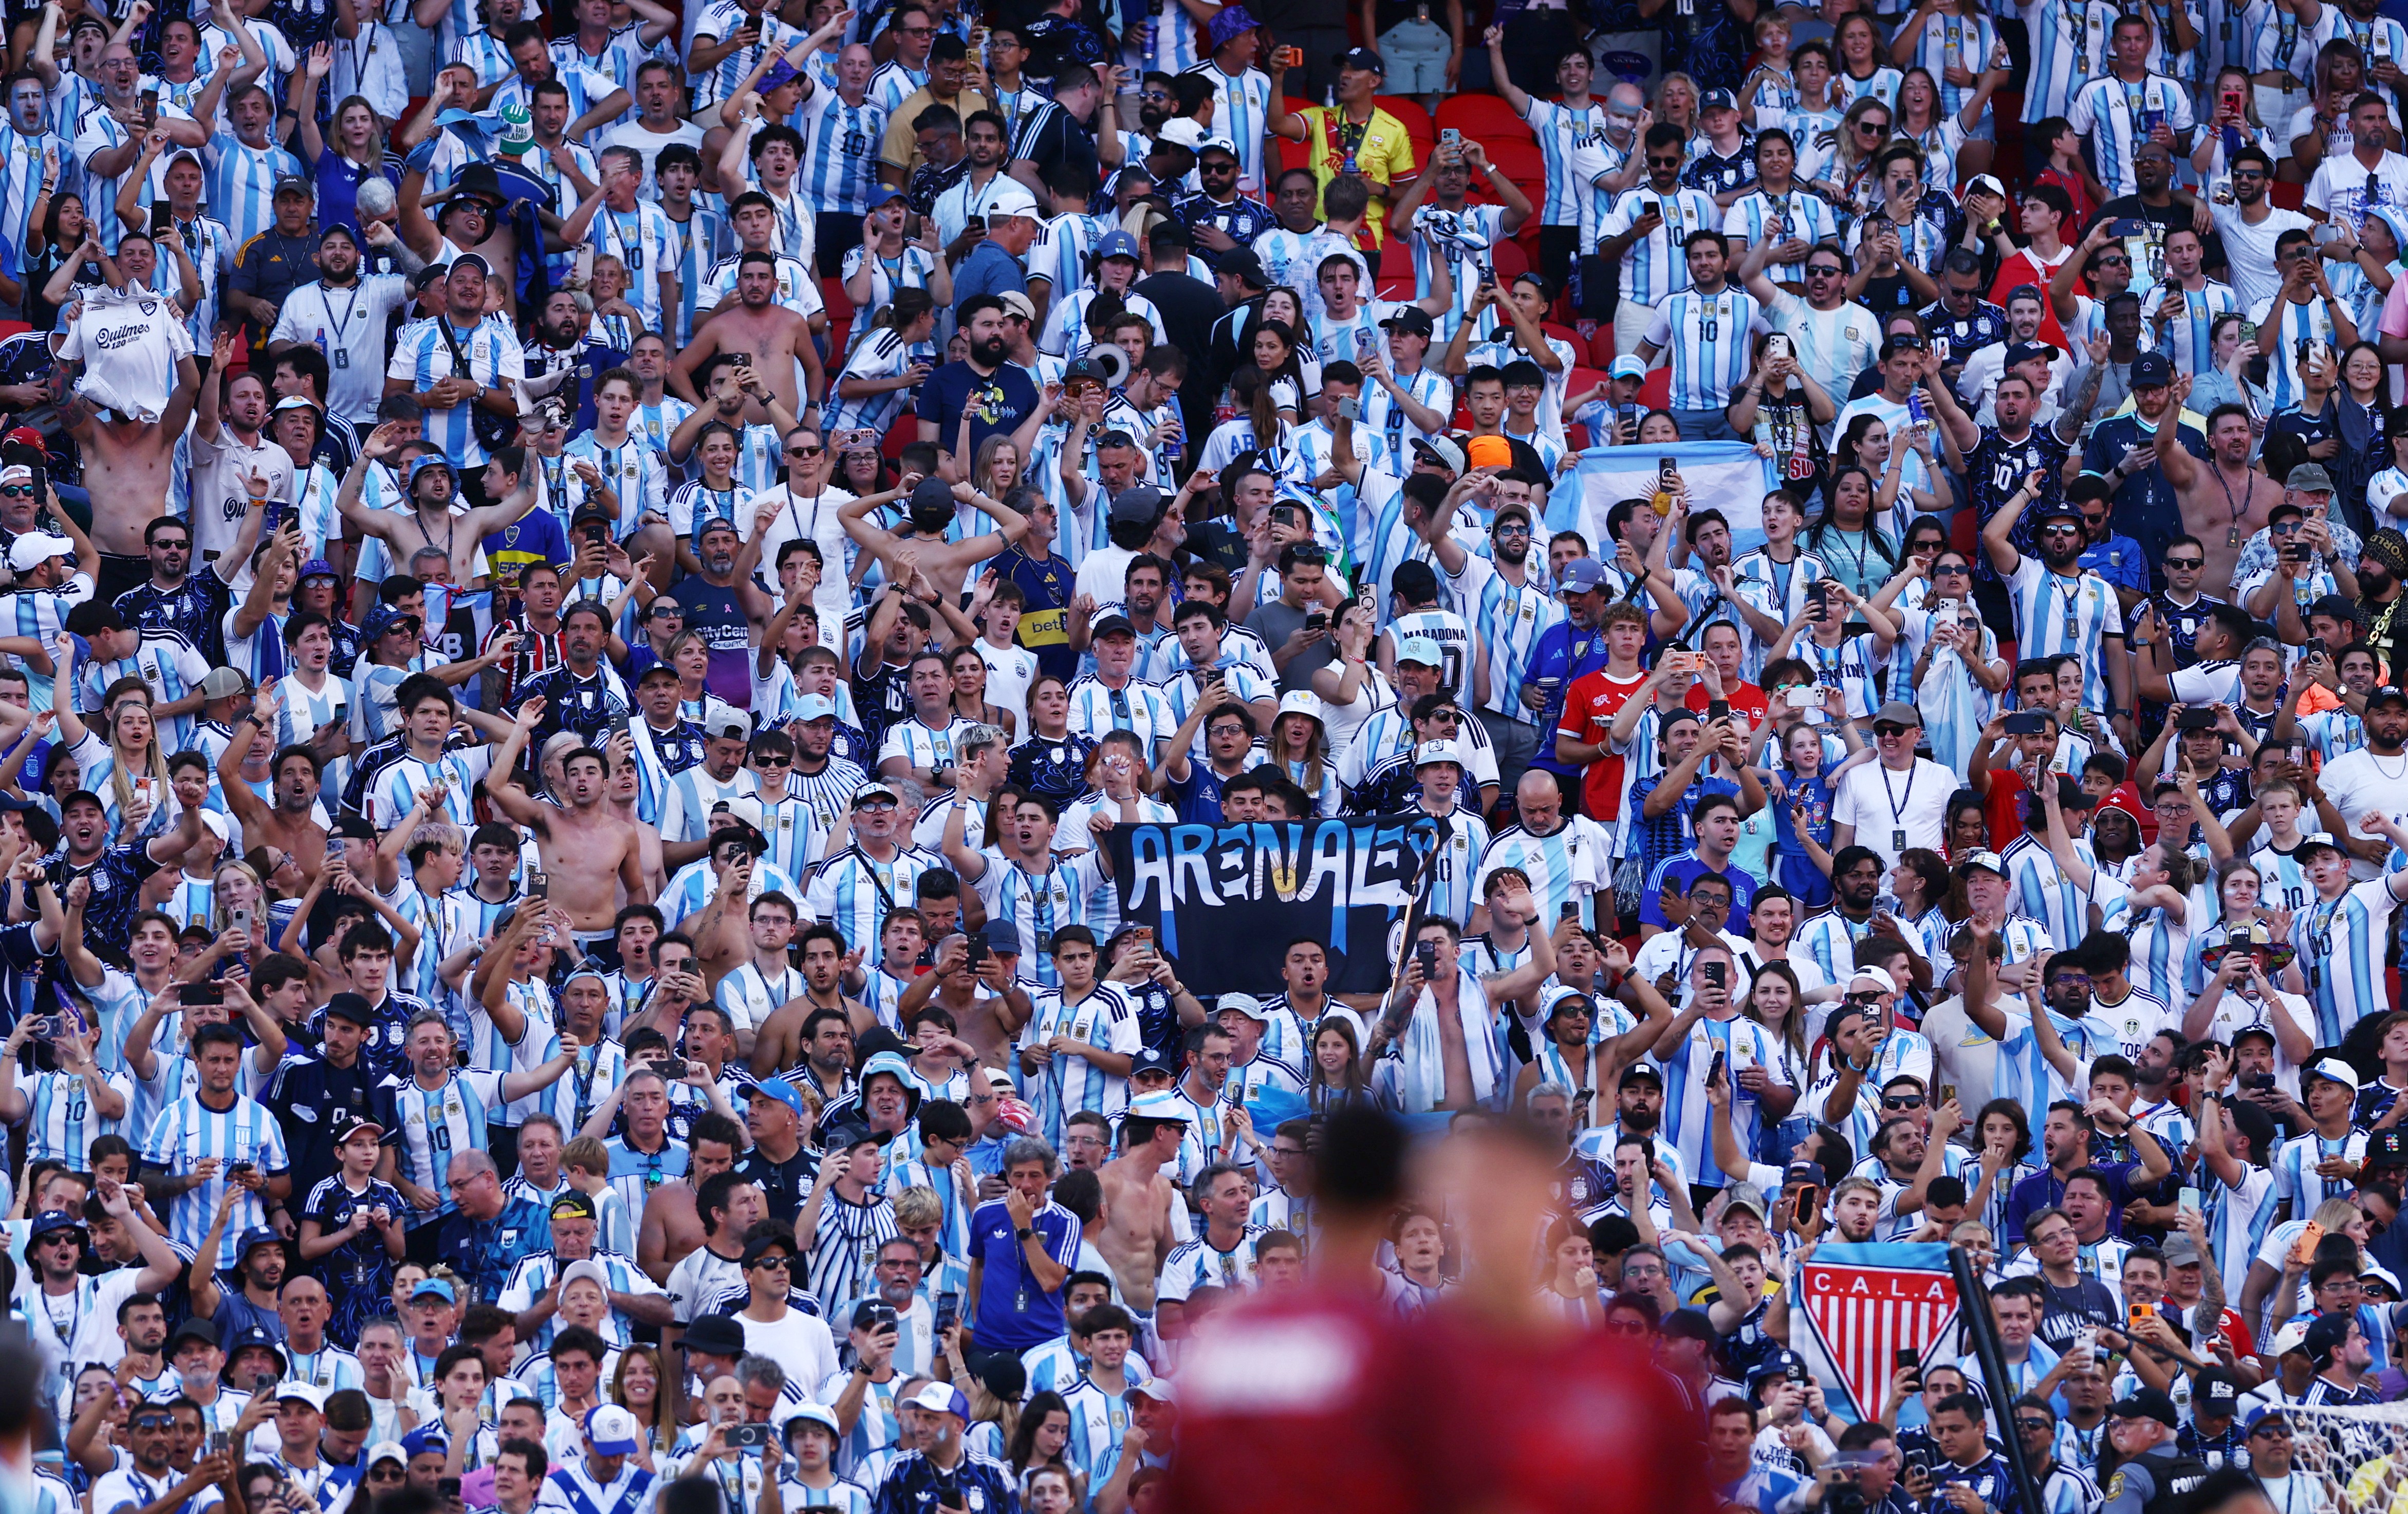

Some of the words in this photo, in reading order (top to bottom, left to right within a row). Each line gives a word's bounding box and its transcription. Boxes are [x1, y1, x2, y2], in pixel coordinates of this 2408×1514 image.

[840, 131, 866, 156] 10
[1666, 226, 1685, 248] 10
[96, 323, 150, 350] Quilmes
[1698, 320, 1718, 342] 10
[112, 340, 126, 350] 120
[1078, 360, 1088, 371] NY
[1386, 409, 1404, 430] 10
[1992, 464, 2012, 489] 10
[224, 496, 249, 523] Qu
[496, 561, 526, 576] EPS
[1403, 627, 1467, 641] MARADONA
[1406, 641, 1420, 655] AFA
[885, 686, 904, 713] 10
[1789, 787, 1815, 801] BLY'S
[2282, 887, 2303, 910] 10
[65, 1100, 87, 1122] 10
[350, 1114, 365, 1124] LA
[426, 1125, 452, 1154] 10
